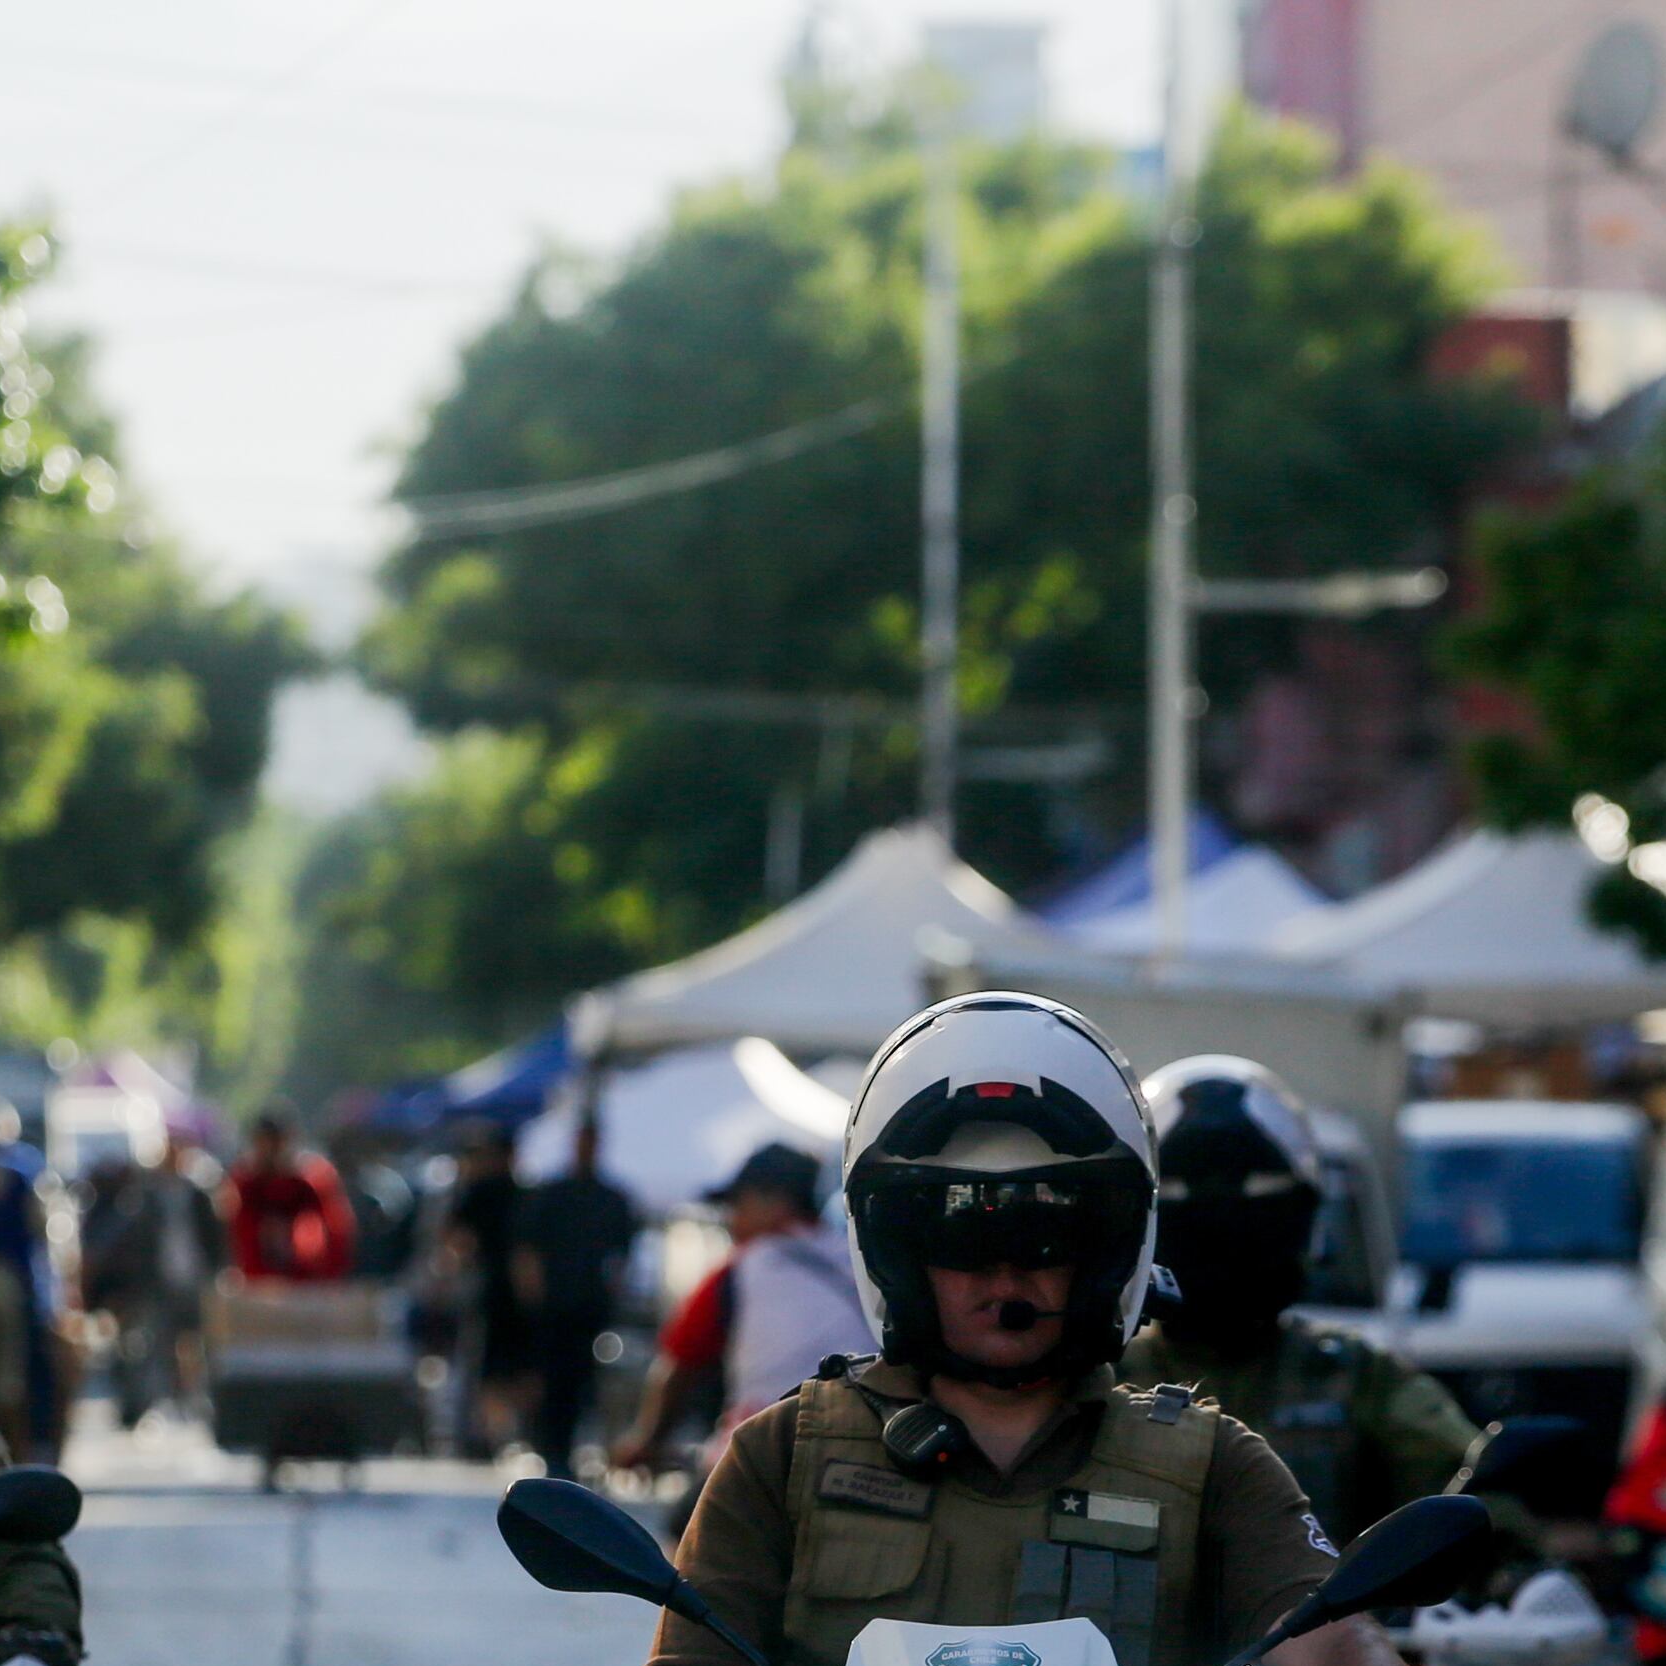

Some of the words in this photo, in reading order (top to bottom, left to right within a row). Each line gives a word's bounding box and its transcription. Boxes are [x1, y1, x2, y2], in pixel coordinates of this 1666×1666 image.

[941, 1648, 1009, 1660] CARABINEROS
[1012, 1652, 1025, 1660] DE
[969, 1656, 997, 1664] CHILE
